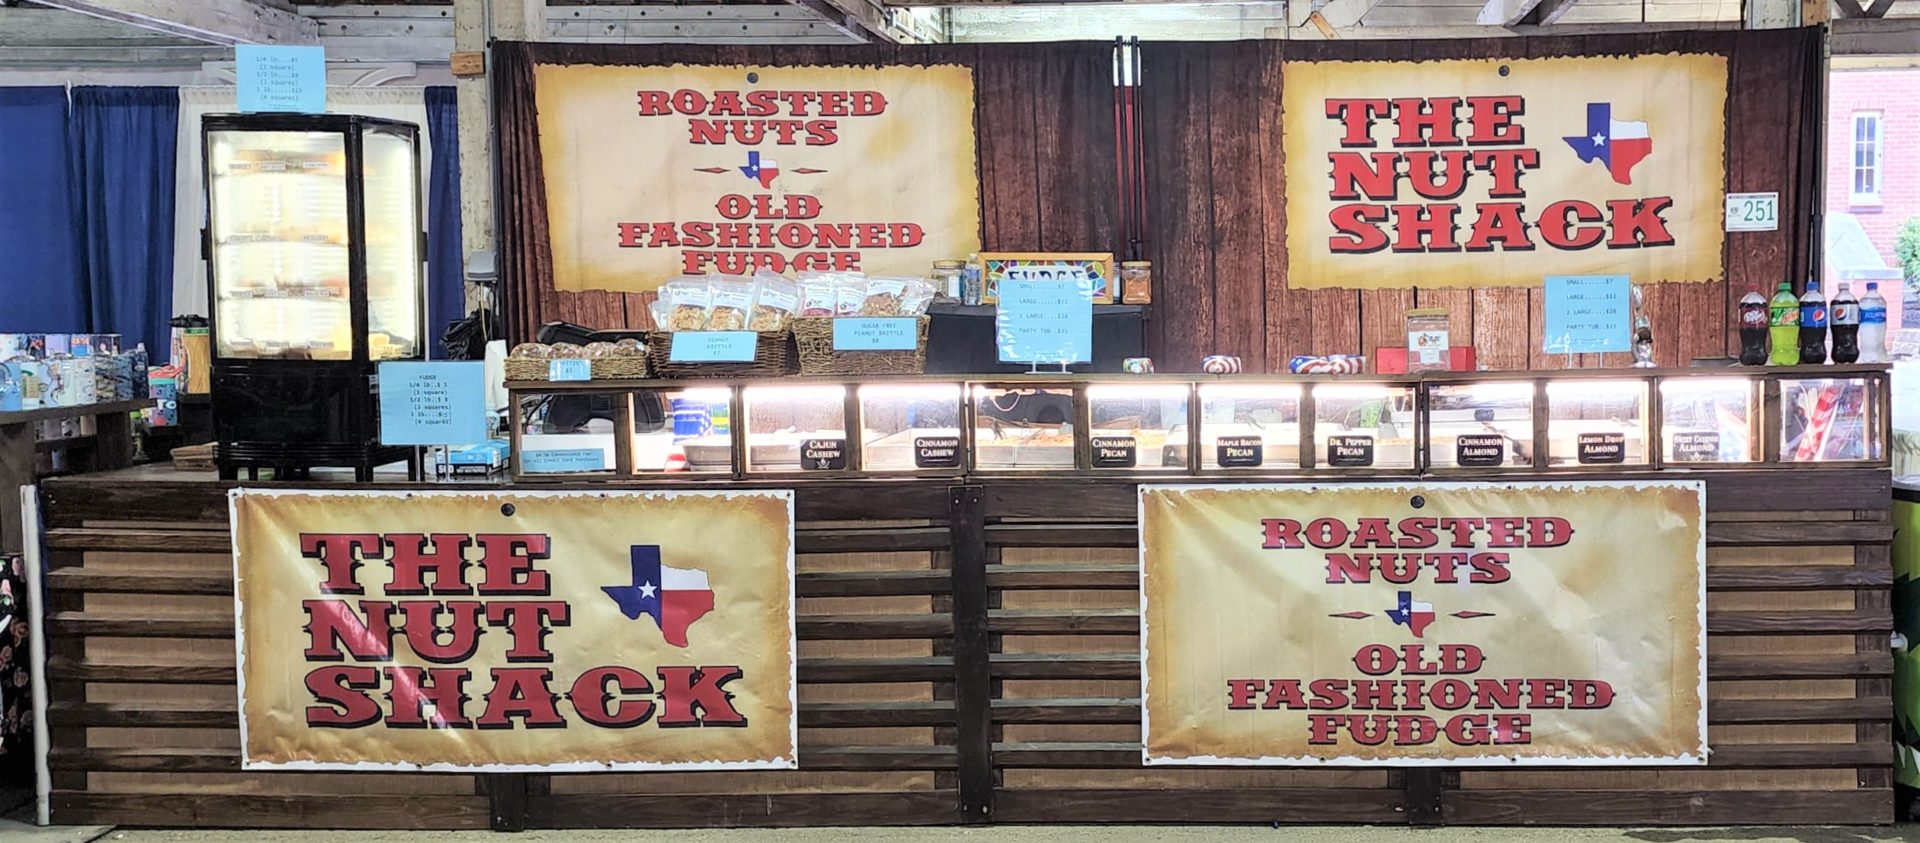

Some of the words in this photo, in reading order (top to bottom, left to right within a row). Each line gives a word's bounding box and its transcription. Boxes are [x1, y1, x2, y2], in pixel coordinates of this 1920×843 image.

[638, 88, 888, 116] ROASTED
[688, 119, 838, 145] NUTS
[1324, 95, 1525, 148] THE
[1328, 148, 1540, 200] NUT
[715, 194, 823, 219] OLD
[1744, 200, 1774, 222] 251
[617, 222, 926, 248] FASHIONED
[1328, 196, 1675, 254] SHACK
[682, 250, 861, 275] FUDGE
[809, 440, 837, 449] CAJUN
[916, 439, 958, 447] CINNAMON
[1092, 438, 1135, 447] CINNAMON
[1329, 438, 1342, 446] DR.
[1345, 437, 1372, 446] PEPPER
[1337, 447, 1364, 456] PECAN
[1458, 437, 1502, 446] CINNAMON
[1462, 447, 1498, 456] ALMOND
[1579, 435, 1603, 444] LEMON
[1605, 435, 1624, 444] DROP
[1584, 444, 1619, 453] ALMOND
[1679, 444, 1714, 452] ALMOND
[806, 450, 840, 458] CASHEW
[921, 449, 954, 457] CASHEW
[1101, 449, 1127, 457] PECAN
[1226, 448, 1253, 457] PECAN
[1260, 516, 1576, 549] ROASTED
[300, 532, 552, 596] THE
[1324, 552, 1511, 584] NUTS
[302, 599, 572, 663] NUT
[1352, 644, 1487, 676] OLD
[304, 665, 748, 730] SHACK
[1226, 679, 1617, 710] FASHIONED
[1308, 714, 1532, 745] FUDGE
